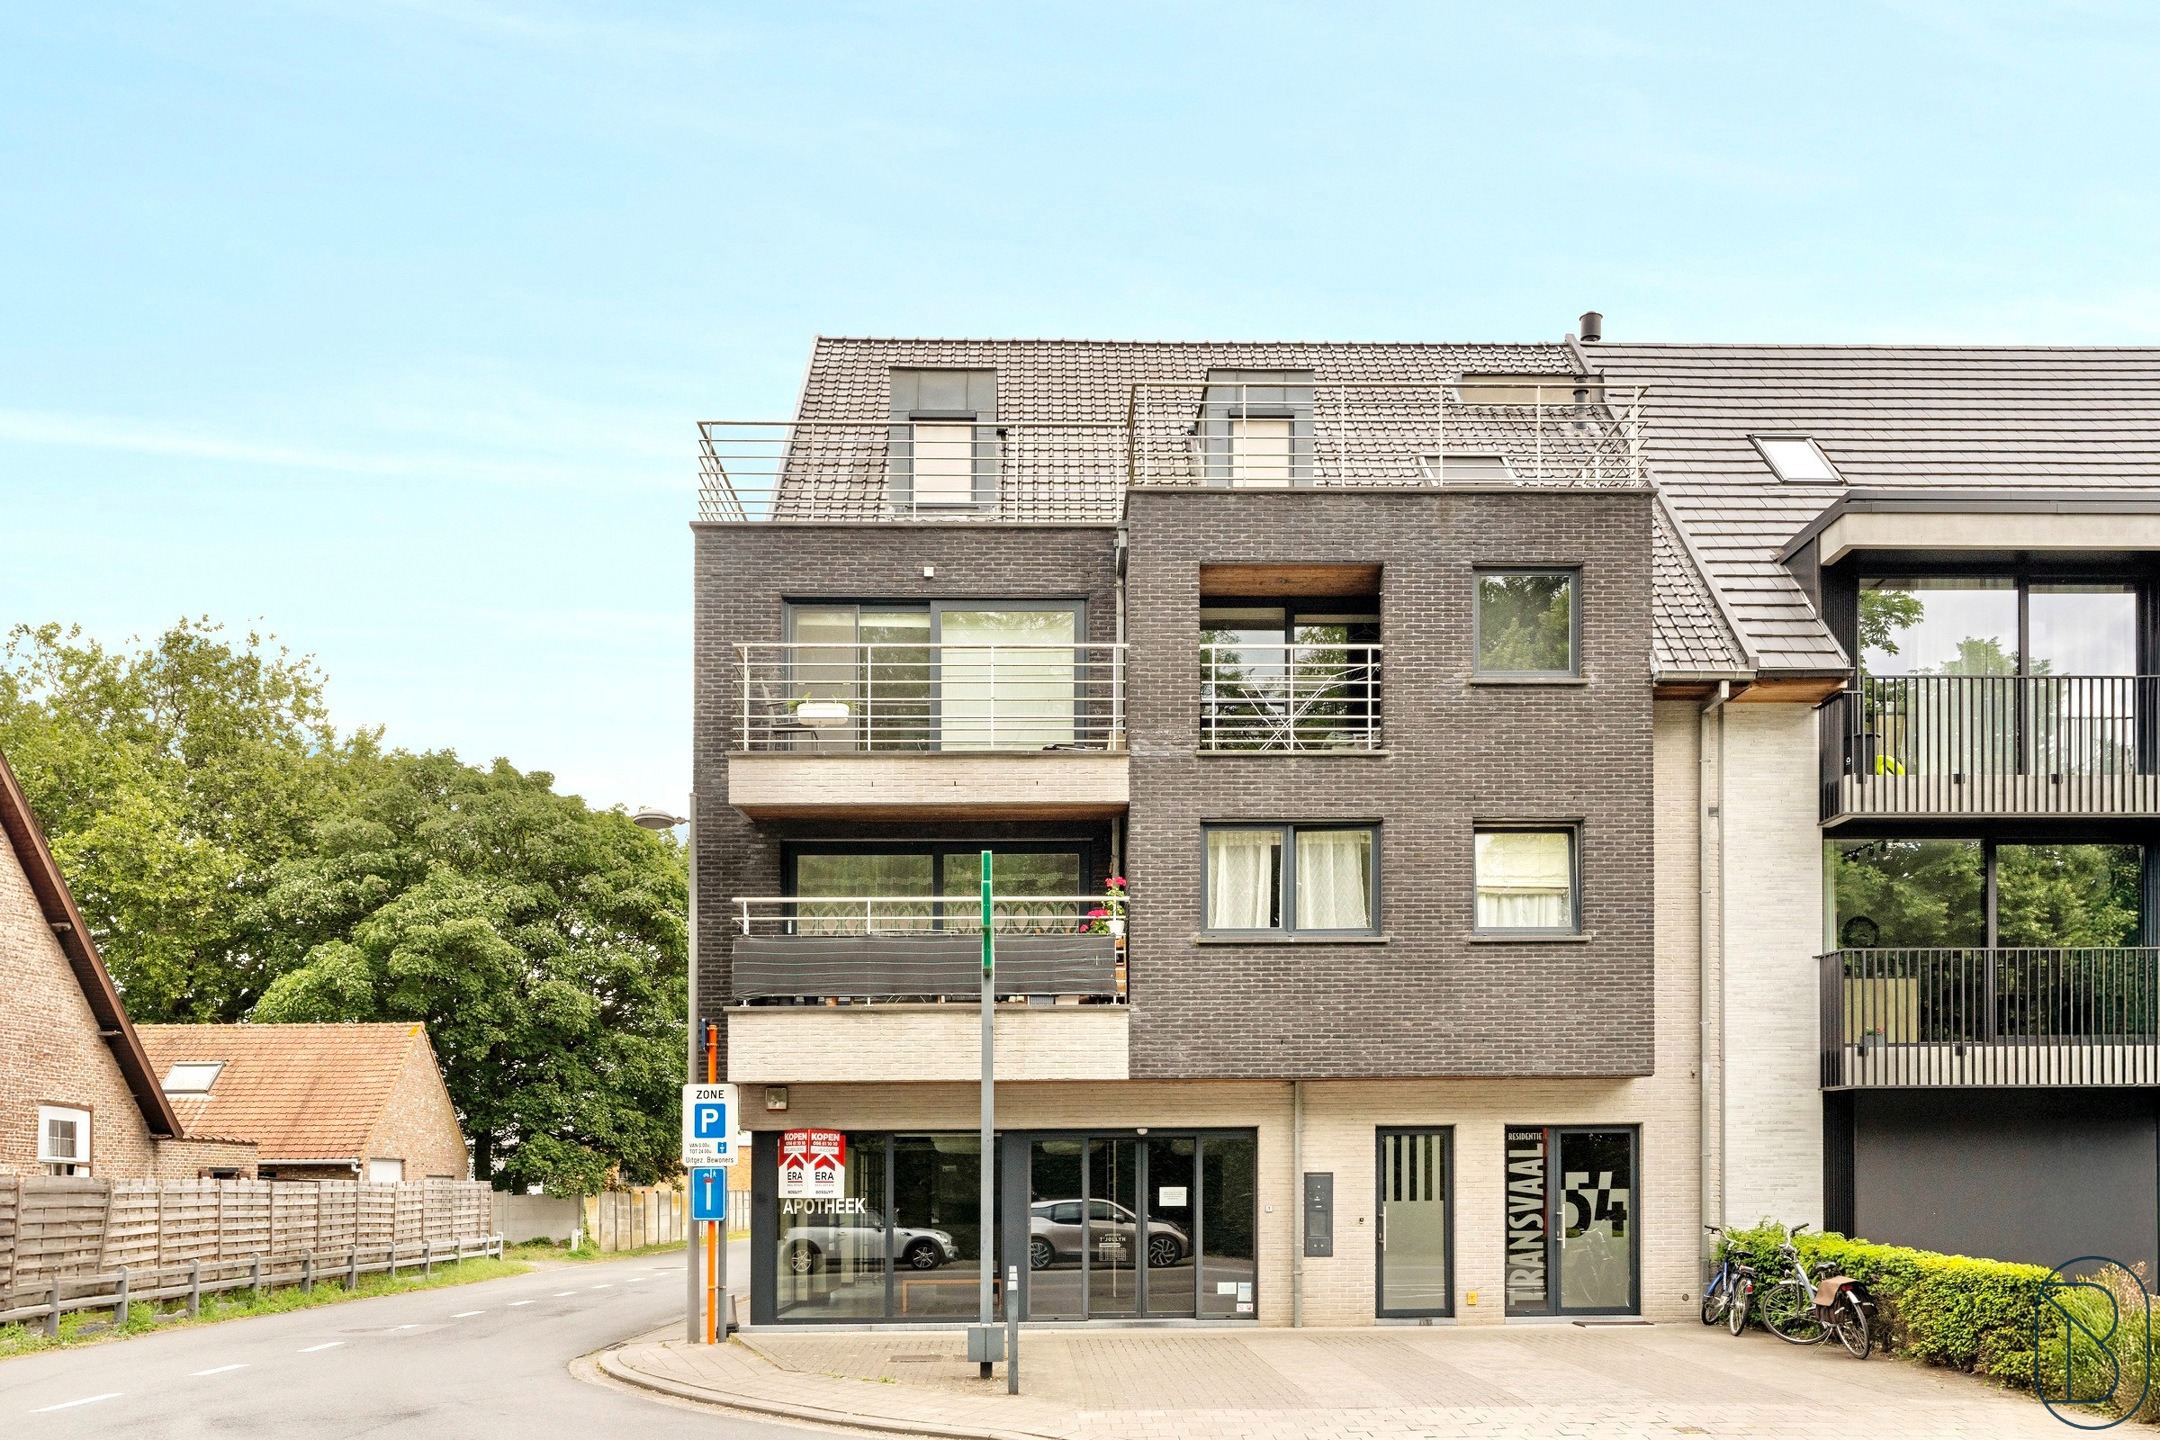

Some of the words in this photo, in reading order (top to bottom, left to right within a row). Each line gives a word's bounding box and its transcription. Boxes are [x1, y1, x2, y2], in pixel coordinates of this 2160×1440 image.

[696, 1089, 725, 1100] ZONE
[701, 1108, 719, 1134] P
[784, 1132, 808, 1141] KOPEN
[811, 1132, 840, 1142] KOPEN
[1508, 1132, 1543, 1141] RESIDENTIE
[707, 1156, 734, 1164] Bewoners
[787, 1171, 803, 1180] ERA
[814, 1171, 835, 1181] ERA
[782, 1197, 866, 1215] APOTHEEK
[1565, 1171, 1628, 1239] 54
[1508, 1143, 1544, 1306] TRANSVAAL
